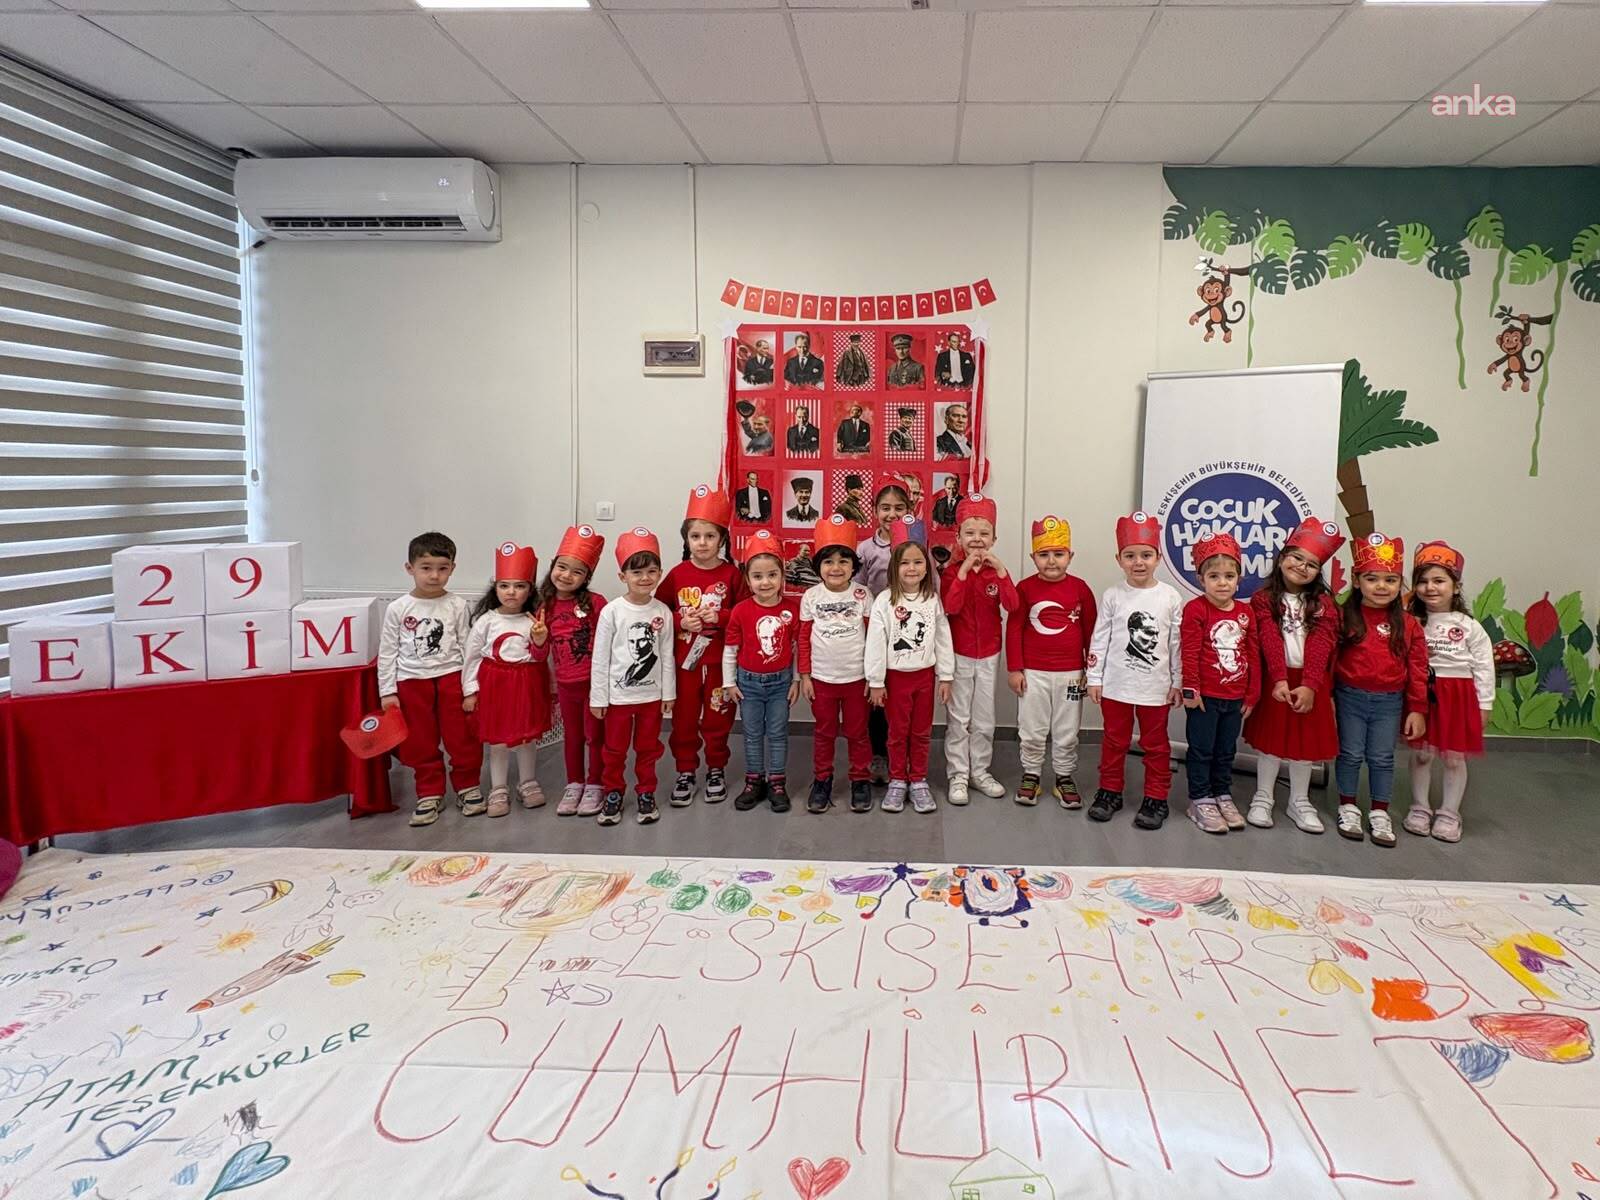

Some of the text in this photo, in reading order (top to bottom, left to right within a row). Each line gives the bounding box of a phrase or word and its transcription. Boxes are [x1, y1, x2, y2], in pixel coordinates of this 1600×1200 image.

[1157, 460, 1312, 517] ESKİŞEHİR BÜYÜKŞEHİR BELEDİYES
[1180, 498, 1281, 528] ÇOCUK
[137, 556, 264, 607] 29
[30, 614, 358, 684] EKİM
[12, 1054, 200, 1119] ATAM
